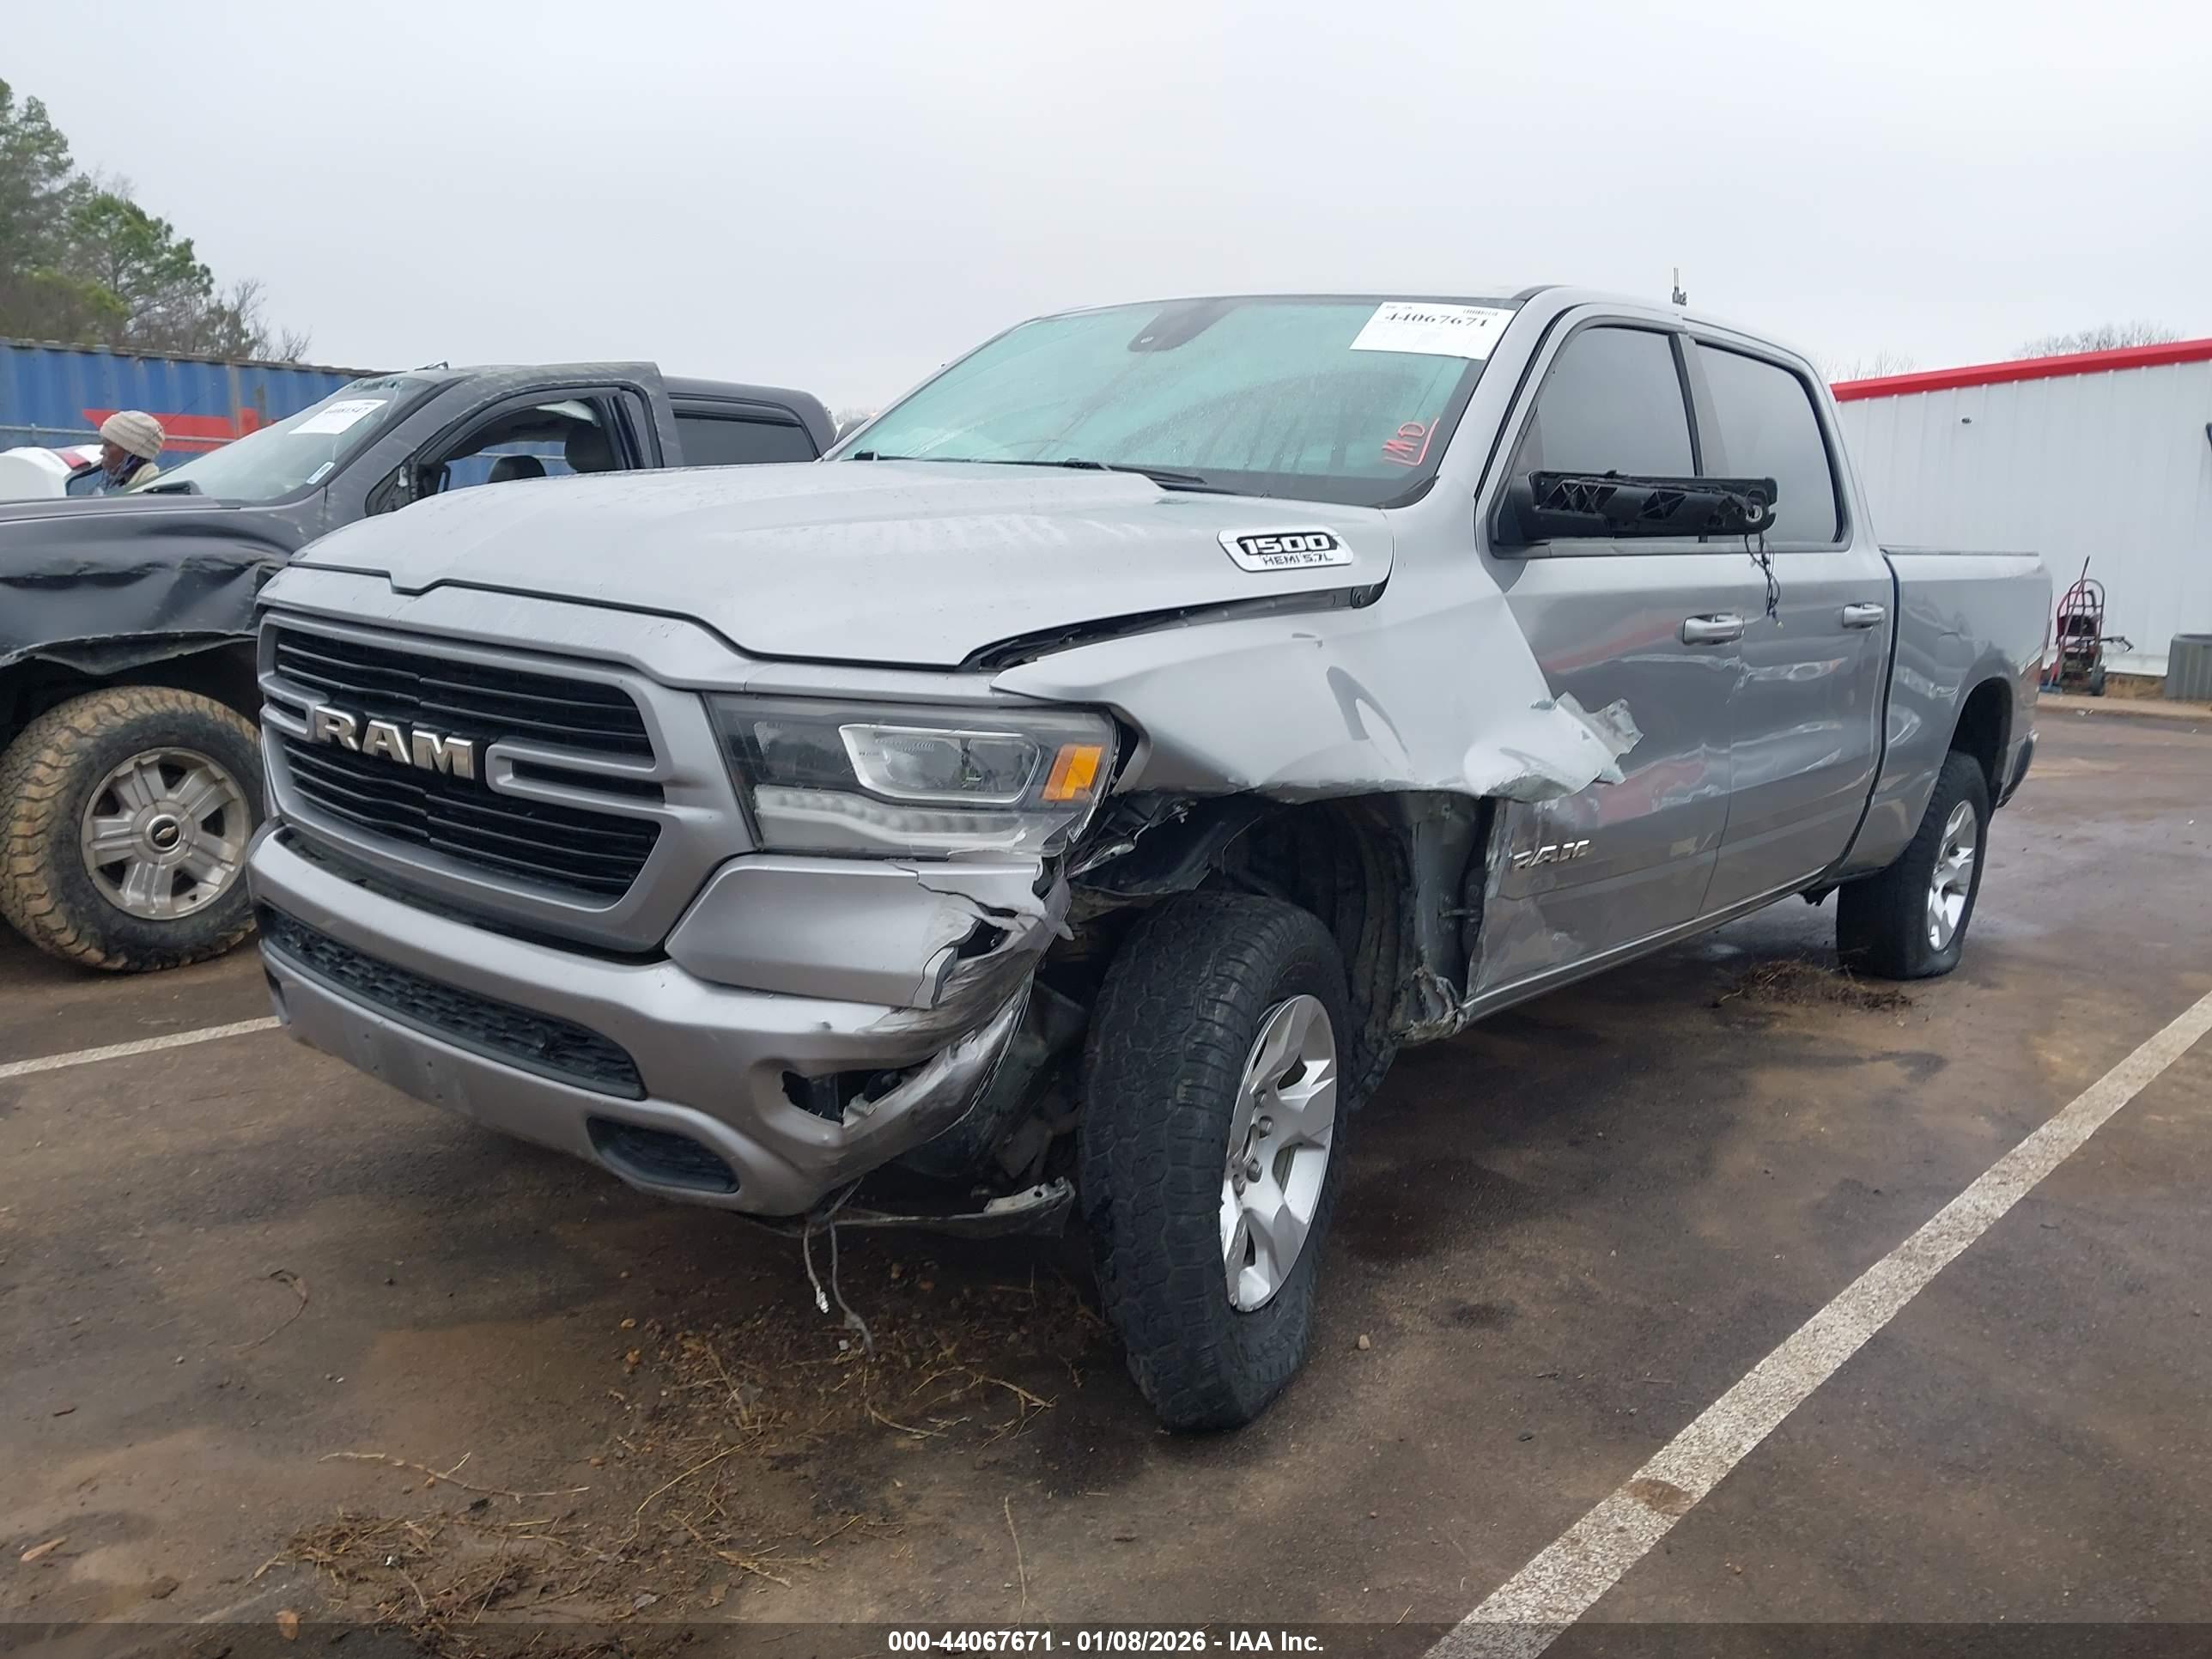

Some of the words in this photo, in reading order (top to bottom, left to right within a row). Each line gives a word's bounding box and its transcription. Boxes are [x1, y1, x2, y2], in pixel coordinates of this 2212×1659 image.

[1385, 312, 1489, 327] 44067671
[1240, 534, 1330, 556] 1500
[1262, 554, 1301, 566] HEMI
[1302, 552, 1334, 563] 5.7L
[315, 705, 475, 780] RAM
